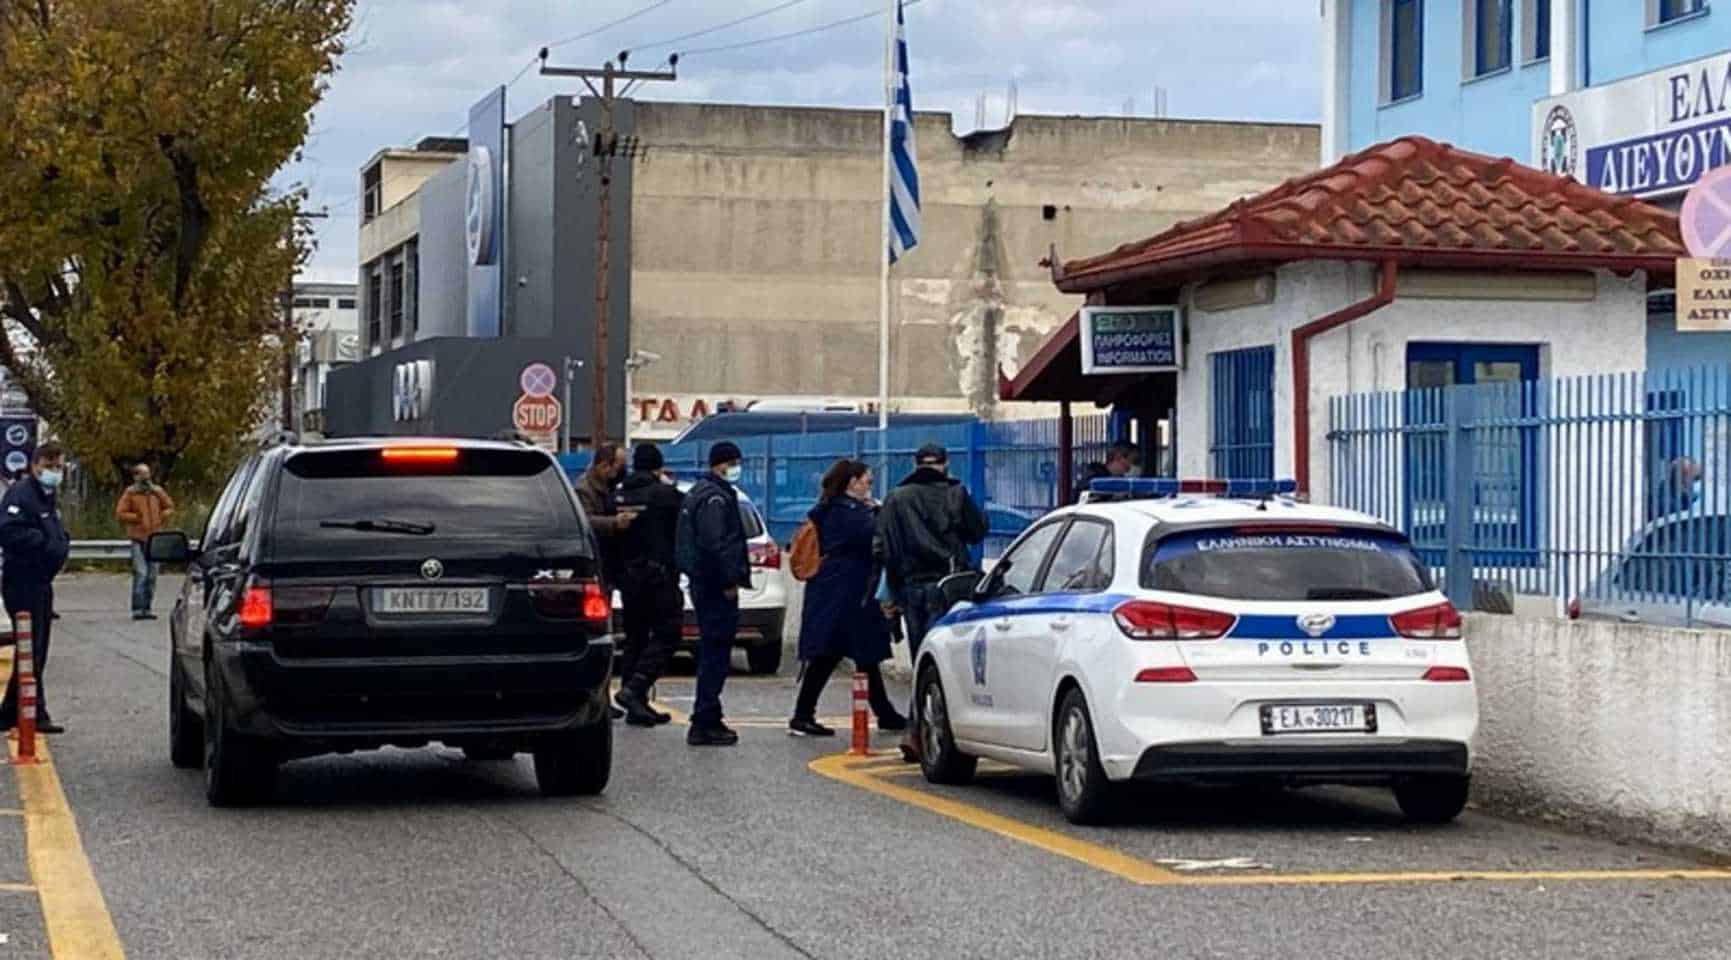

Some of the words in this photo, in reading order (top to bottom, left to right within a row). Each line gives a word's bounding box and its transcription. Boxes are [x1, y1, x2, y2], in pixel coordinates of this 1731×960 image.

[1095, 350, 1171, 365] INFORMATION
[518, 403, 557, 426] STOP
[1258, 641, 1370, 655] POLICE
